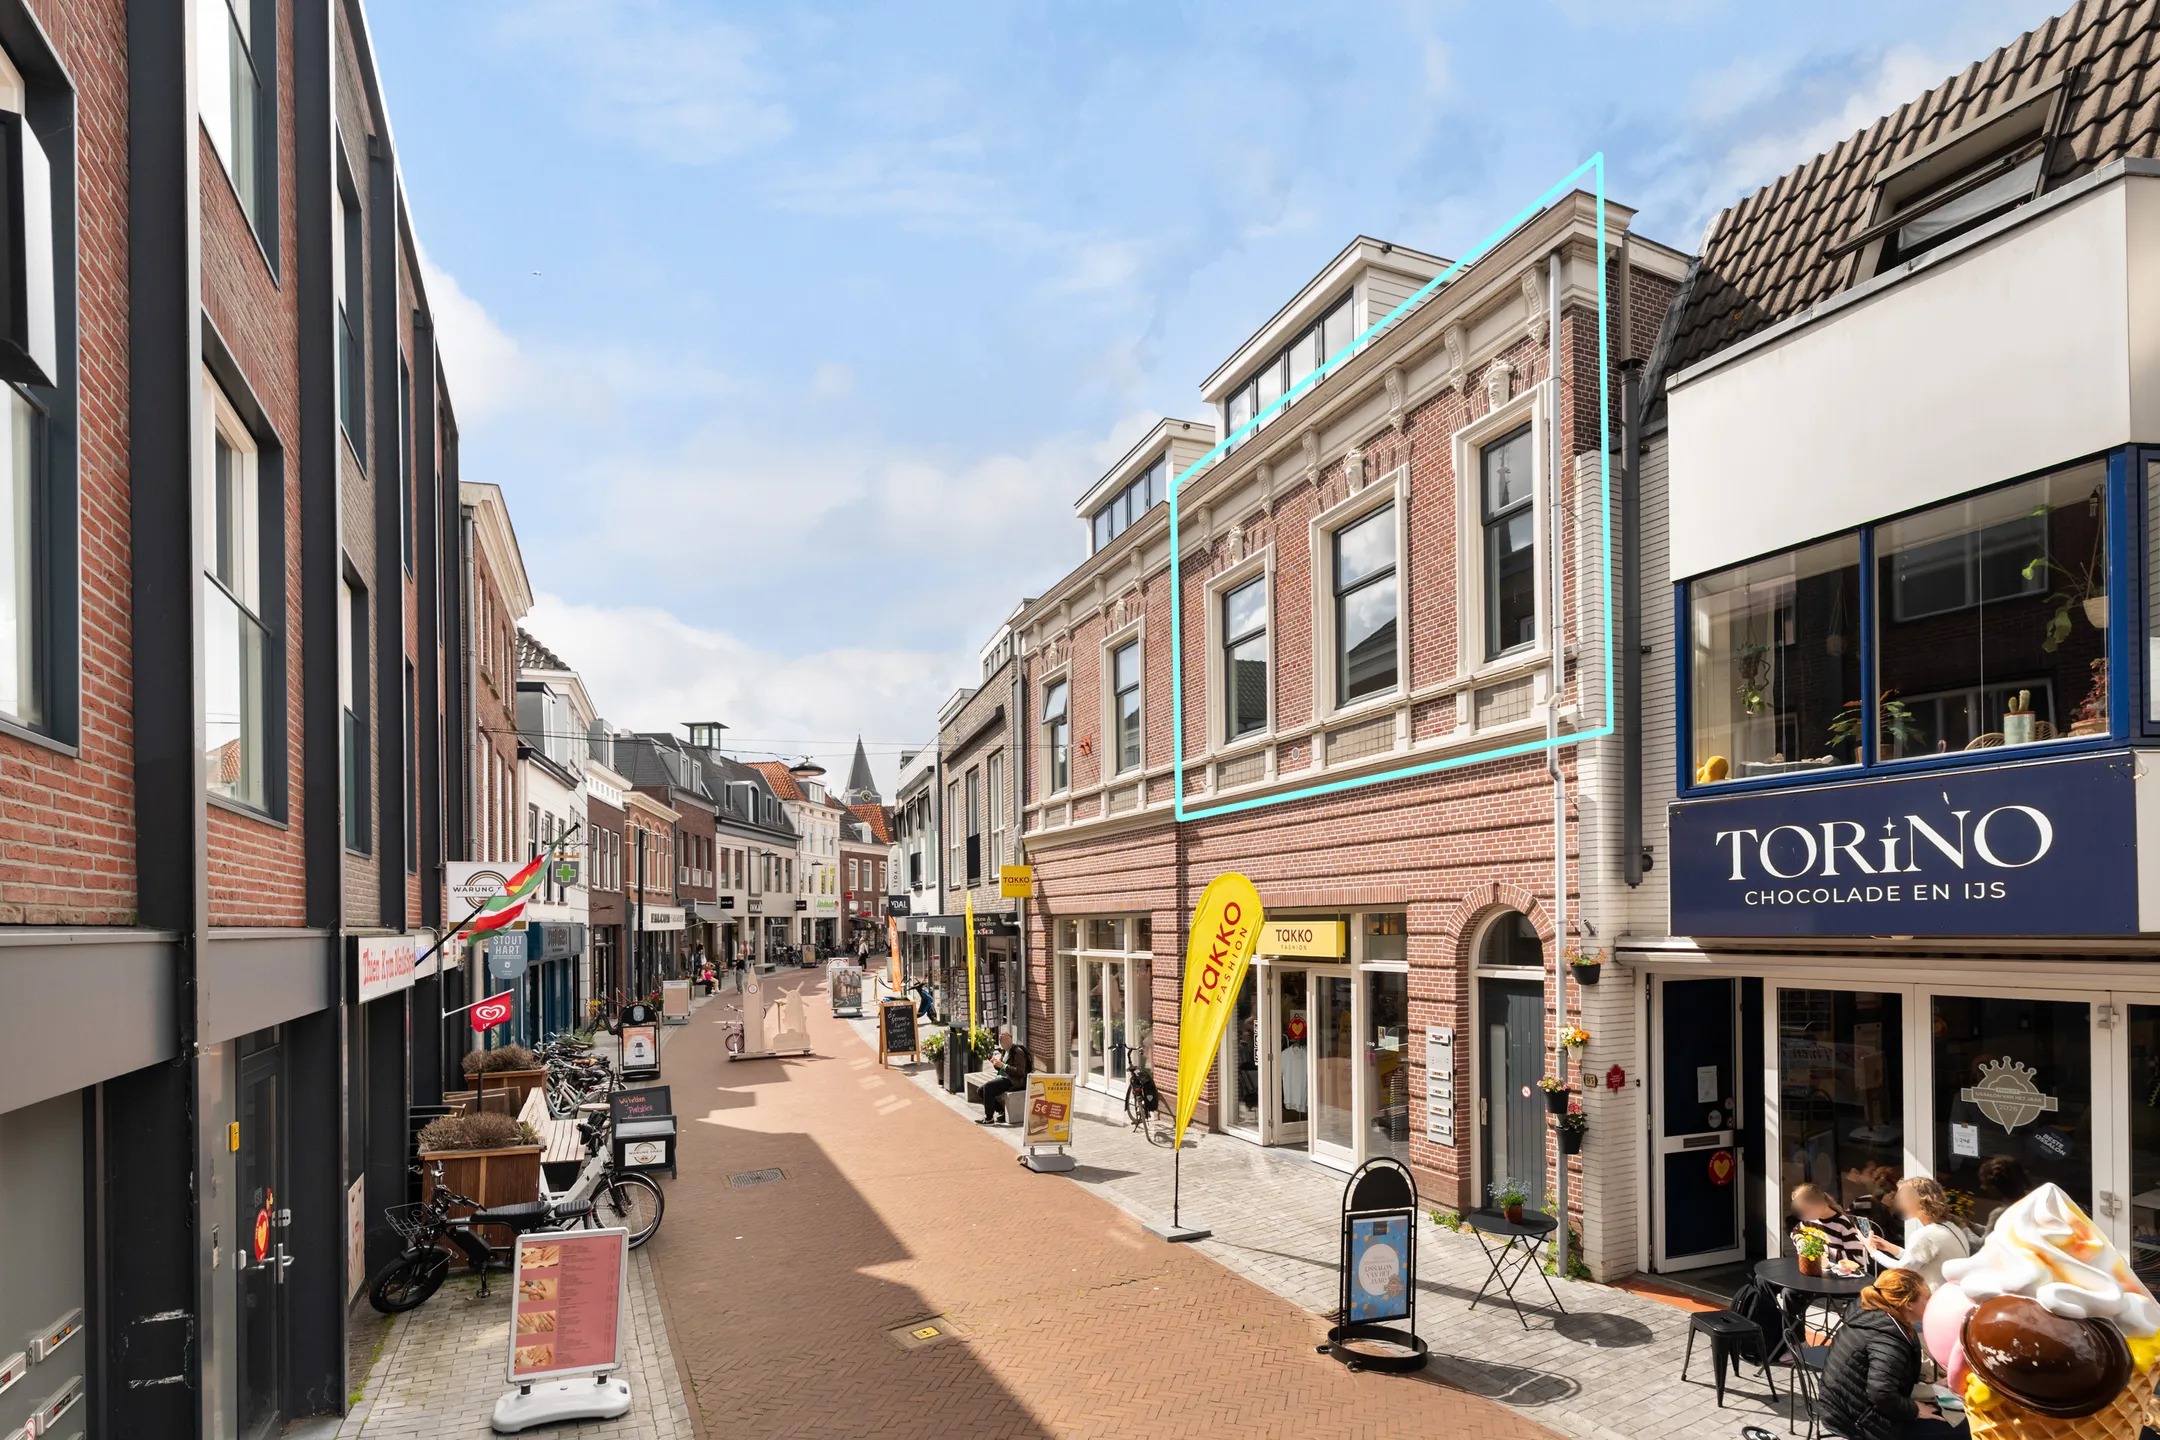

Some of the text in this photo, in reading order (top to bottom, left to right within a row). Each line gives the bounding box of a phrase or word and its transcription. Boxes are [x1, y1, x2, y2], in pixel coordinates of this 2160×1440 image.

[1744, 881, 2006, 906] CHOCOLADE EN IJS
[493, 935, 523, 945] STOUT
[495, 945, 520, 955] HART
[1216, 927, 1248, 1004] FASHION
[2043, 1133, 2065, 1149] BESTE
